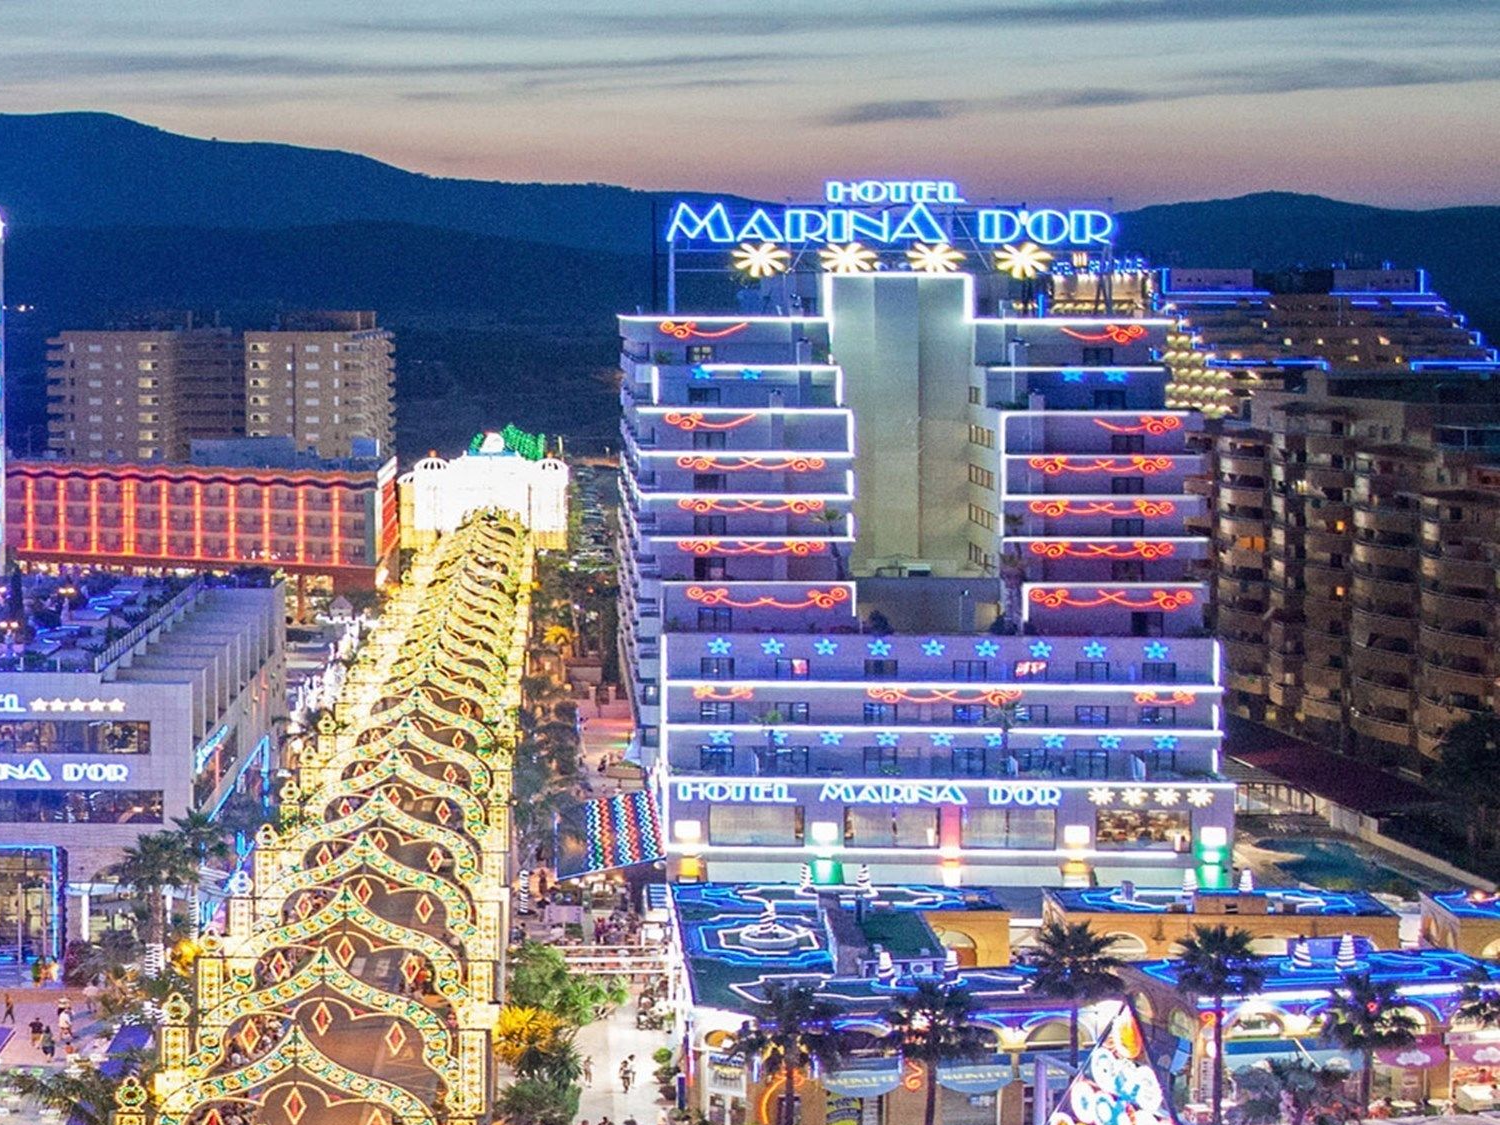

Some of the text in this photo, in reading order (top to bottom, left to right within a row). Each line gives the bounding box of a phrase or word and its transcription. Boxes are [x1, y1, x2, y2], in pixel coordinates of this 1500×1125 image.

[826, 181, 964, 203] HOTEL
[666, 202, 1114, 245] MARINA D'OR
[62, 763, 129, 782] D'OR
[677, 781, 797, 803] HOTEL
[818, 782, 967, 805] MARINA
